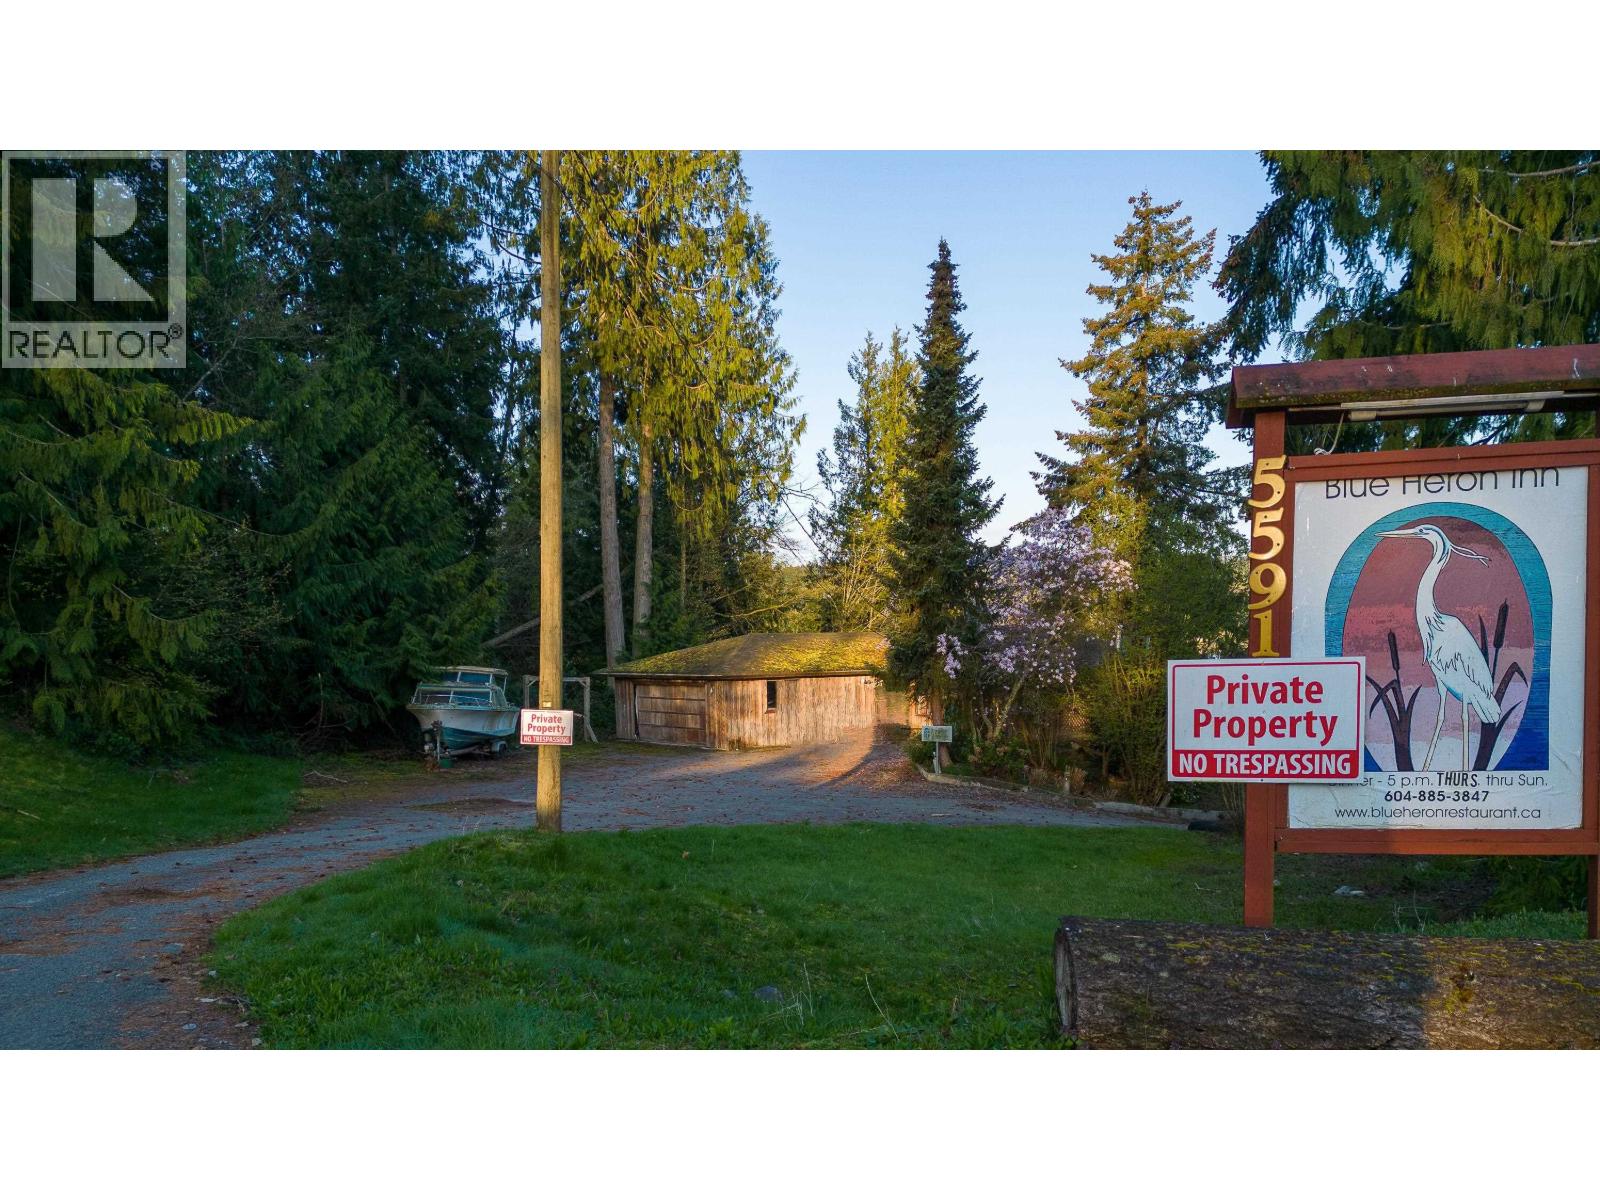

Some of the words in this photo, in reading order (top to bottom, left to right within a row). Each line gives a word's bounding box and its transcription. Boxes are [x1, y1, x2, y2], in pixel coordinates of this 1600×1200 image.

[1325, 477, 1390, 499] Blue
[1402, 471, 1499, 495] Heron
[1512, 467, 1560, 488] Inn
[1248, 455, 1287, 658] 5591
[1207, 674, 1324, 704] Private
[531, 714, 562, 723] Private
[528, 723, 565, 734] Property
[1193, 709, 1338, 747] Property
[533, 736, 569, 744] TRESPASSING
[1179, 753, 1207, 774] NO
[1213, 753, 1350, 775] TRESPASSING
[1387, 774, 1396, 787] 5
[1401, 775, 1433, 788] p.m.
[1486, 774, 1513, 787] thru
[1518, 773, 1548, 787] Sun.
[1384, 790, 1489, 802] 604-885-3847
[1334, 806, 1541, 820] www.blueheronrestaurant.ca
